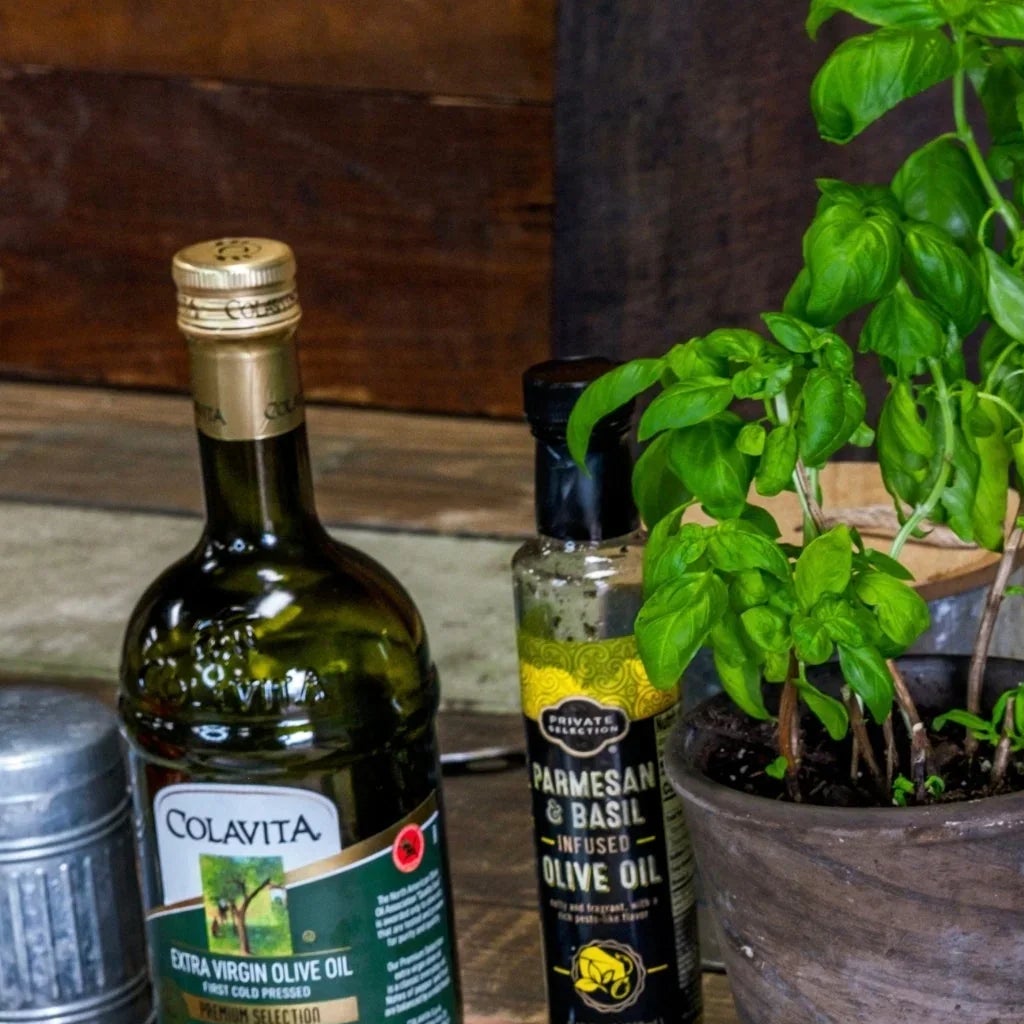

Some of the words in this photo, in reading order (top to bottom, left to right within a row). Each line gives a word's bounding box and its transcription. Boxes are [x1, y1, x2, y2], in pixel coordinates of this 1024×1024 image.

[547, 725, 619, 736] SELECTION
[548, 715, 614, 727] PRIVATE
[532, 761, 656, 798] PARMESAN
[546, 798, 563, 825] &
[571, 797, 646, 829] BASIL
[166, 808, 322, 846] COLAVITA
[557, 834, 630, 855] INFUSED
[542, 854, 611, 893] OLIVE
[620, 854, 663, 890] OIL
[170, 948, 211, 978] EXTRA
[212, 959, 268, 984] VIRGIN
[272, 959, 321, 983] OLIVE
[325, 955, 353, 979] OIL
[202, 981, 229, 996] FIRST
[231, 986, 259, 999] COLD
[262, 986, 311, 1000] PRESSED
[201, 1001, 249, 1023] PREMIUM
